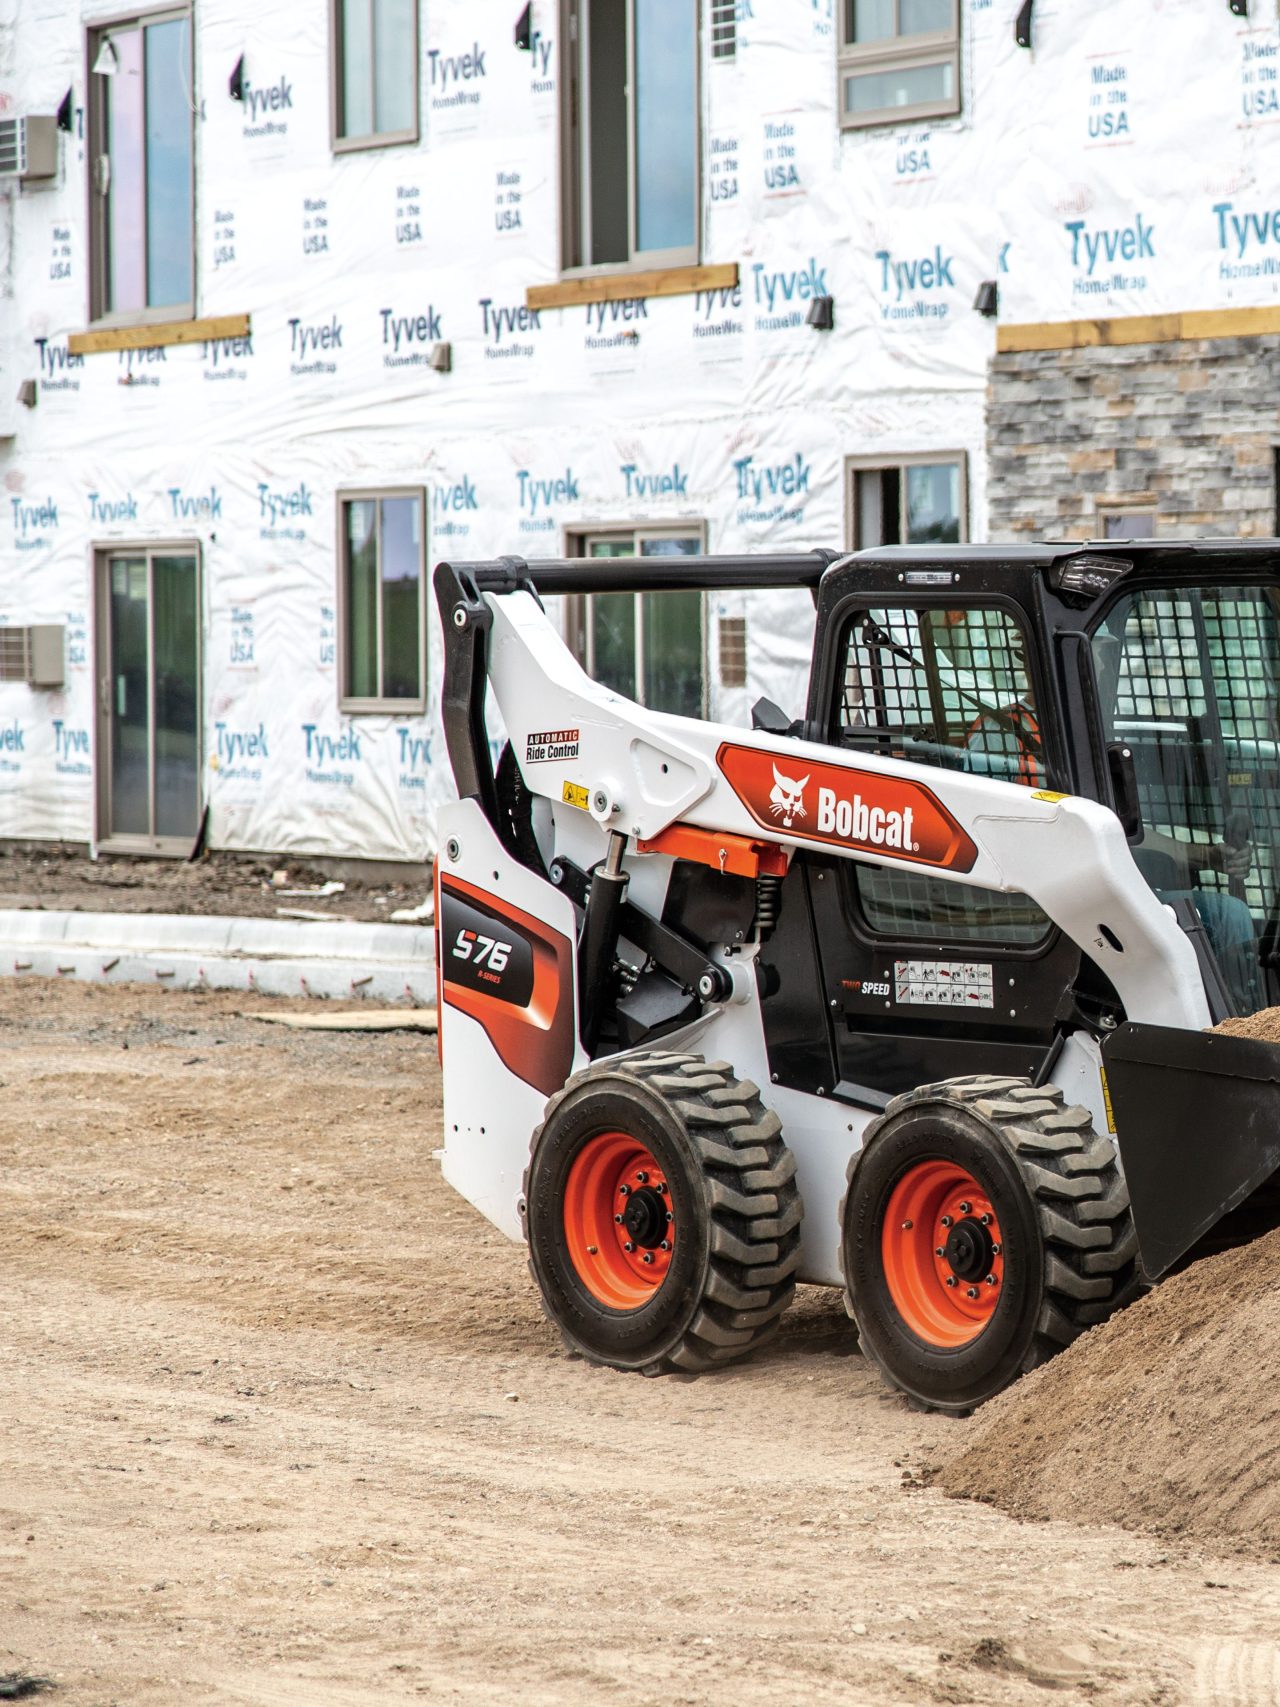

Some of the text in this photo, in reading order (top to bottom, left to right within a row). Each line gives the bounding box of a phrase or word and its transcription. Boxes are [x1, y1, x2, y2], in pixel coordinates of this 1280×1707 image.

[428, 42, 486, 92] Tyvek
[1243, 90, 1279, 116] USA
[1089, 111, 1130, 138] USA
[897, 150, 931, 174] USA
[711, 178, 739, 200] USA
[764, 165, 800, 187] USA
[396, 223, 422, 243] USA
[496, 210, 522, 231] USA
[303, 235, 328, 254] USA
[1065, 213, 1156, 275] Tyvek
[753, 258, 827, 311] Tyvek
[877, 246, 955, 301] Tyvek
[1073, 276, 1147, 295] HomeWrap
[380, 305, 441, 351] Tyvek
[480, 299, 541, 342] Tyvek
[288, 315, 342, 359] Tyvek
[384, 353, 430, 368] HomeWra
[258, 483, 312, 525] Tyvek
[517, 468, 578, 515] Tyvek
[11, 496, 57, 534] Tyvek
[230, 643, 254, 663] USA
[215, 722, 268, 764] Tyvek
[302, 724, 361, 766] Tyvek
[527, 730, 579, 745] AUTOMATIC
[526, 743, 580, 762] Ride Control
[817, 787, 914, 851] Bobcat
[453, 929, 513, 972] S76
[478, 970, 501, 984] R-SERIES
[862, 982, 890, 996] SPEED
